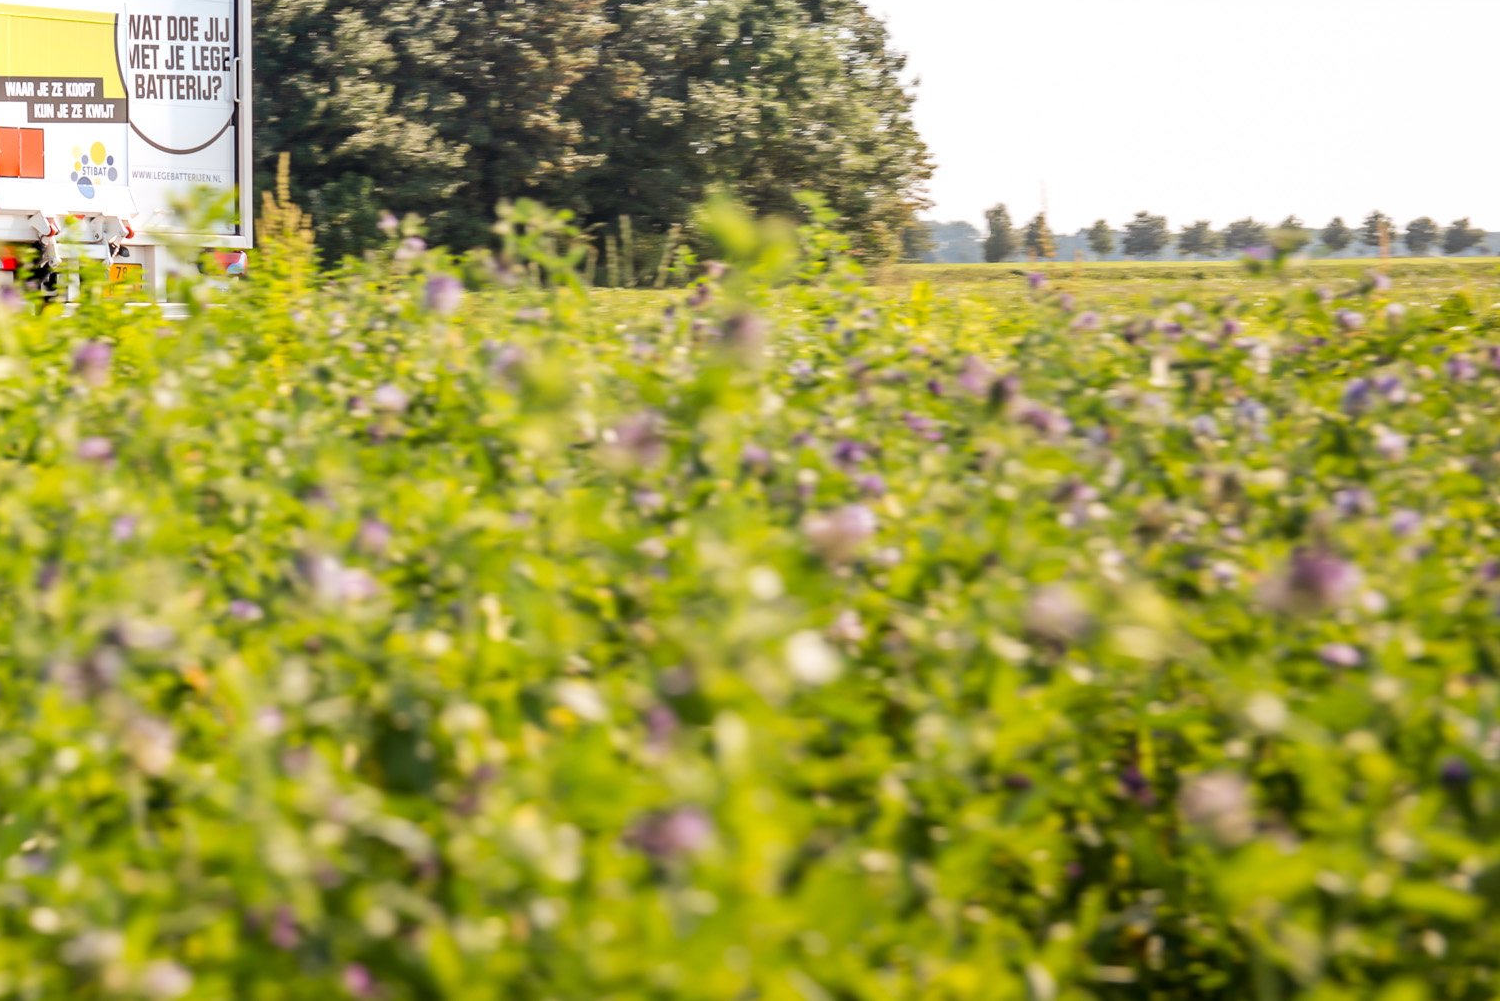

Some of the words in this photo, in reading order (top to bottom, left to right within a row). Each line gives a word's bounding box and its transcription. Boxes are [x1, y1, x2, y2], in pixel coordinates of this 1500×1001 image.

[167, 16, 199, 42] DOE
[204, 17, 230, 42] JIJ
[165, 45, 184, 71] JE
[192, 46, 231, 72] LEGE
[5, 81, 35, 97] WAAR
[37, 82, 49, 97] JE
[51, 82, 63, 97] ZE
[66, 82, 95, 97] KOOPT
[135, 74, 222, 101] BATTERIJ?
[34, 103, 54, 118] KUN
[57, 103, 68, 118] JE
[71, 104, 83, 118] ZE
[85, 104, 115, 118] KWIJT
[82, 166, 107, 176] STIBAT
[132, 170, 222, 183] WWW.LEGEBATTERIJEN.NL
